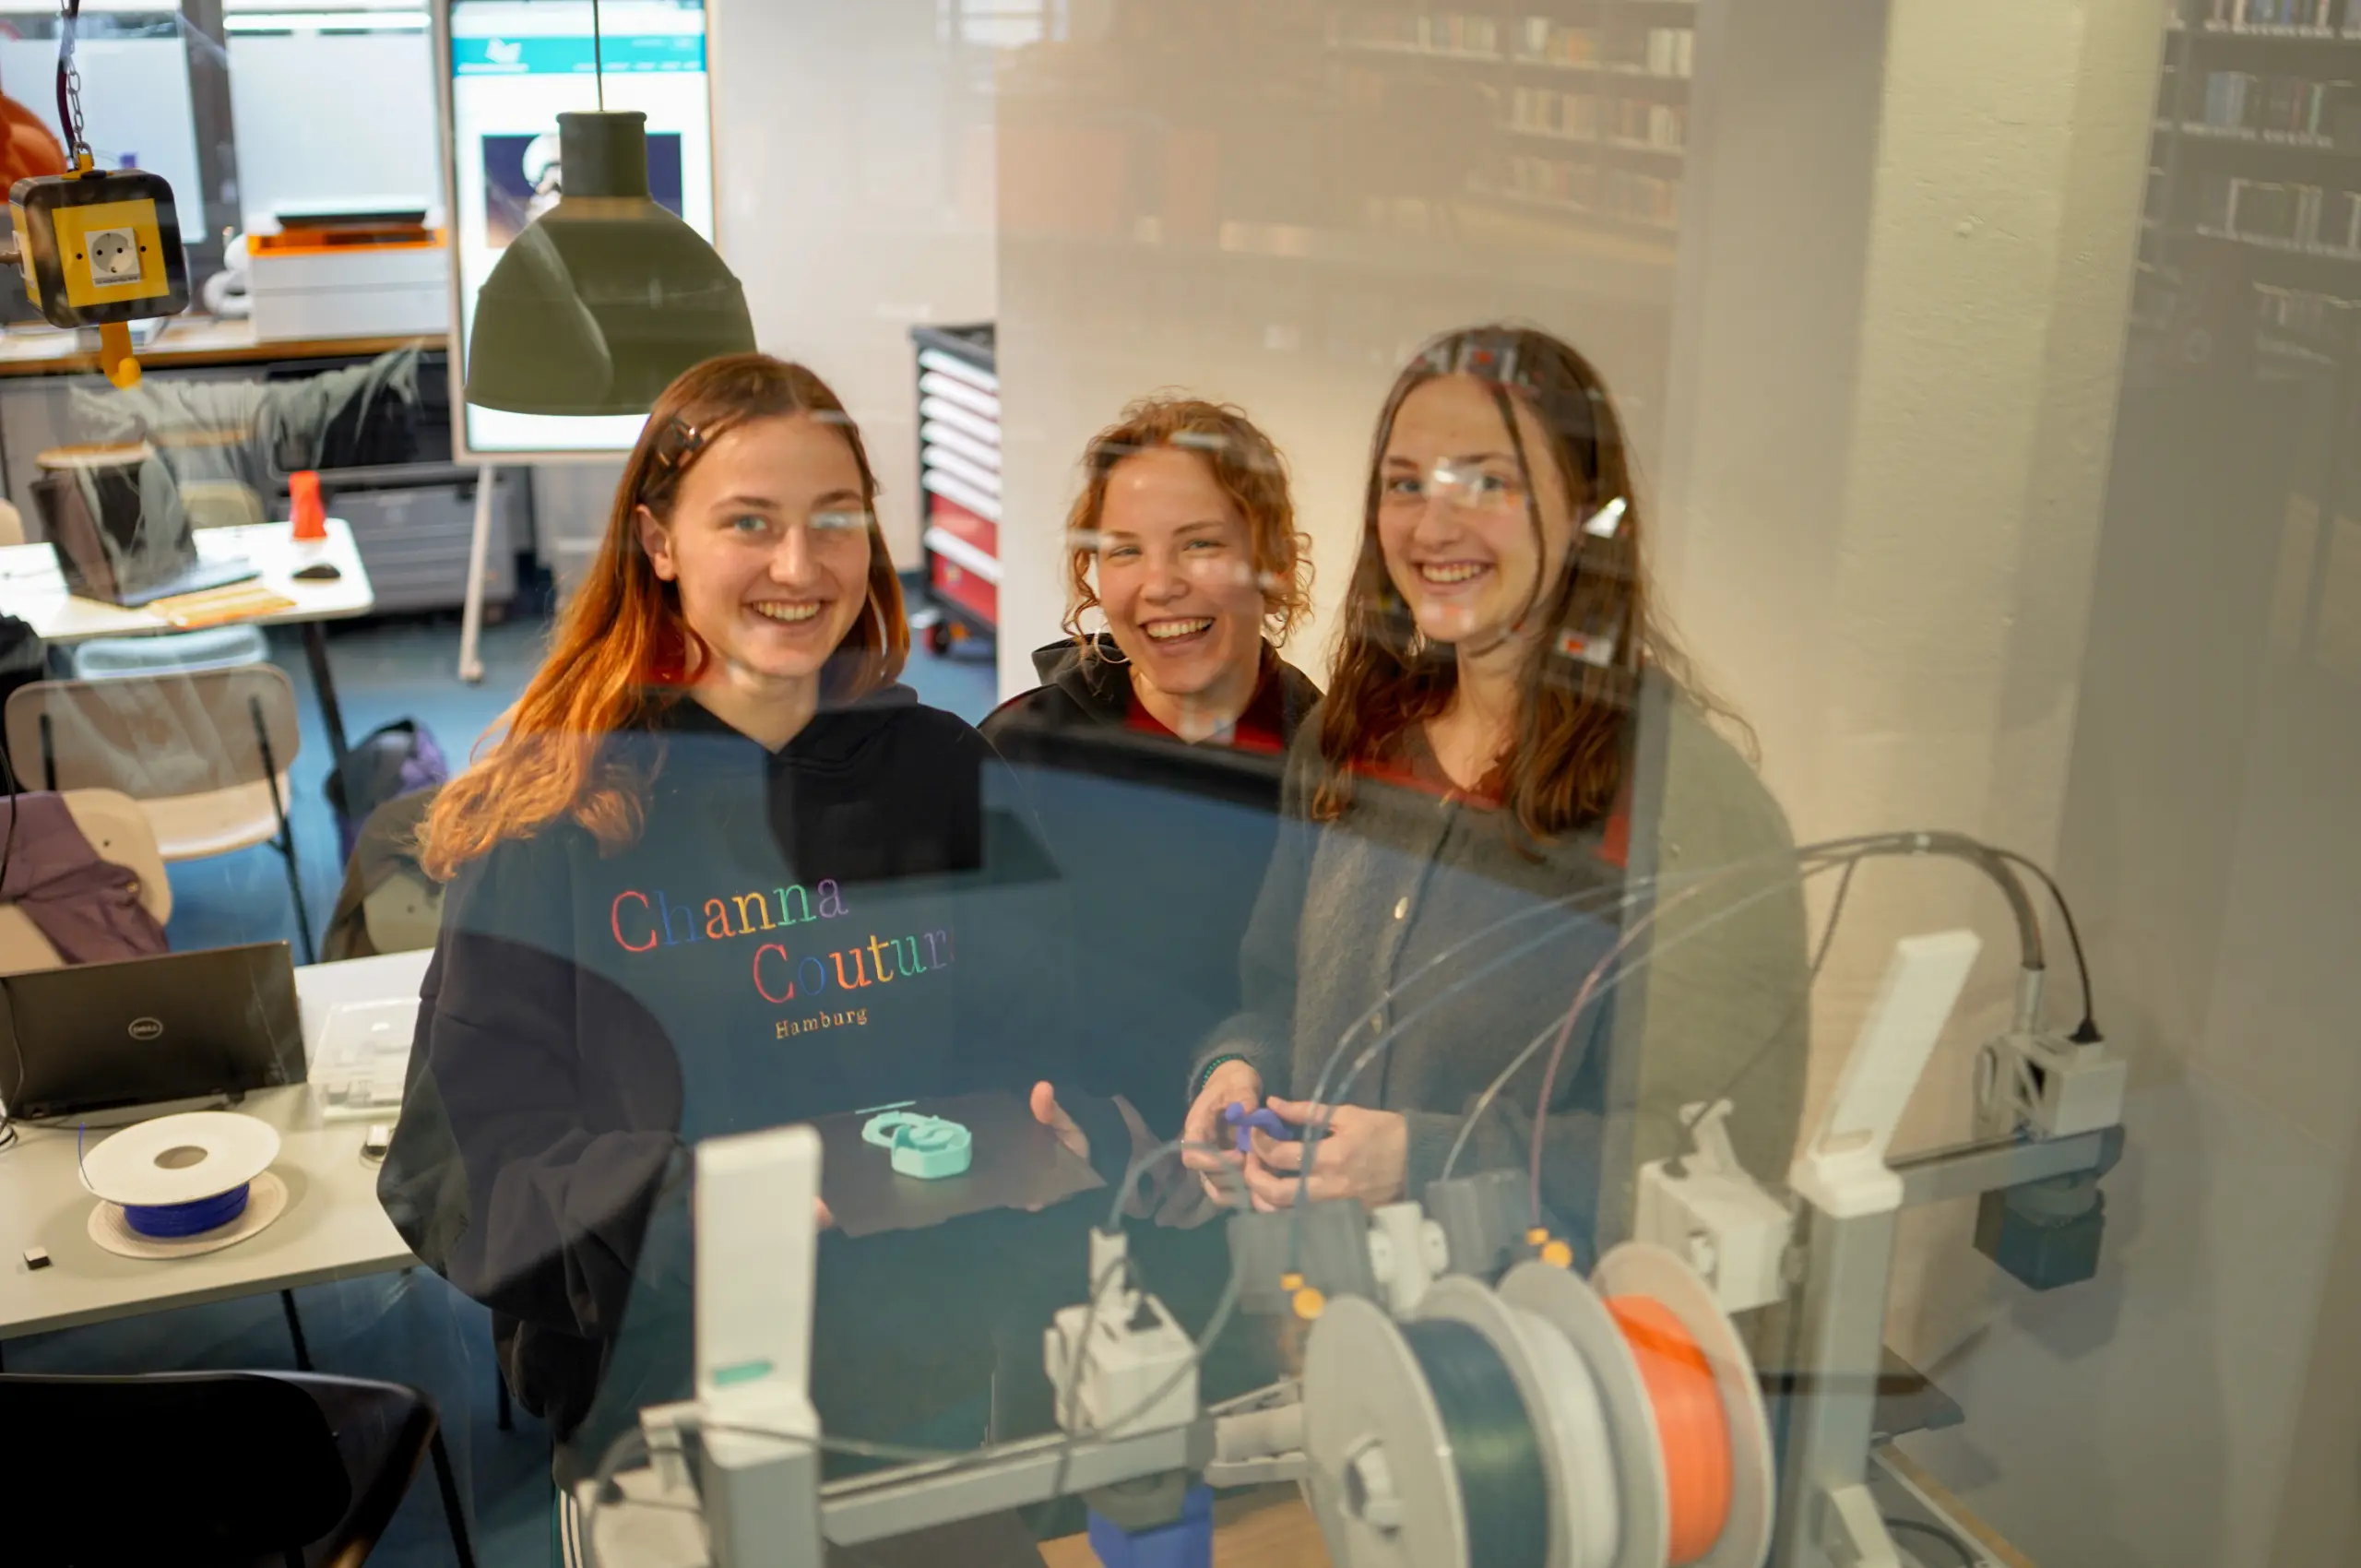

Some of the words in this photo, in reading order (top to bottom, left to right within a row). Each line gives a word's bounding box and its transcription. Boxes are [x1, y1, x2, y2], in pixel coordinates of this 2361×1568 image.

[611, 878, 849, 953] Channa
[753, 926, 955, 1004] Coutur
[775, 1007, 869, 1039] Hamburg
